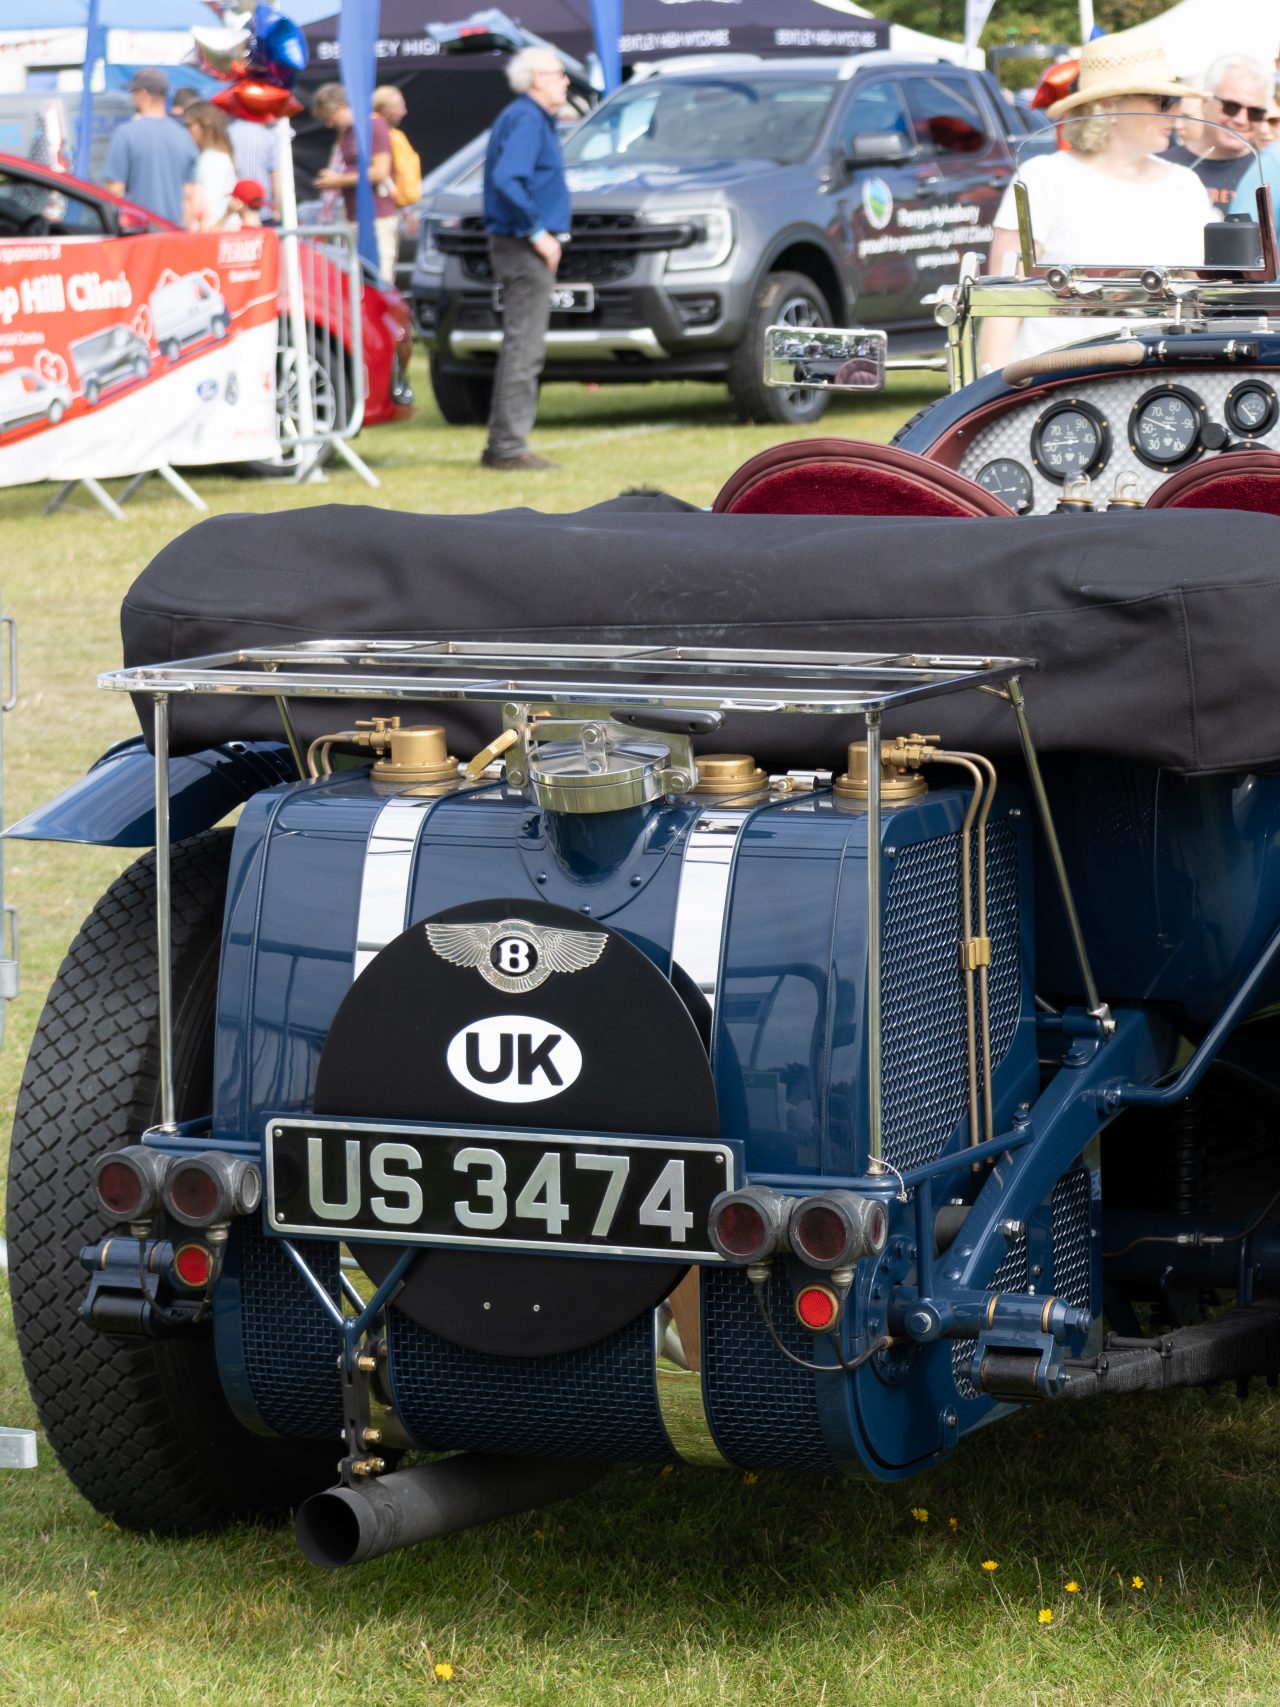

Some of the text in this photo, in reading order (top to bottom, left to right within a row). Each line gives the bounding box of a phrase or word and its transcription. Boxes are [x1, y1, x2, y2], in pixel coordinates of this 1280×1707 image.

[20, 273, 66, 315] Hill
[66, 270, 133, 312] Climb
[1050, 454, 1062, 465] 30
[1148, 439, 1160, 450] 30
[498, 937, 531, 974] B
[465, 1031, 565, 1087] UK
[307, 1136, 695, 1243] US 3474
